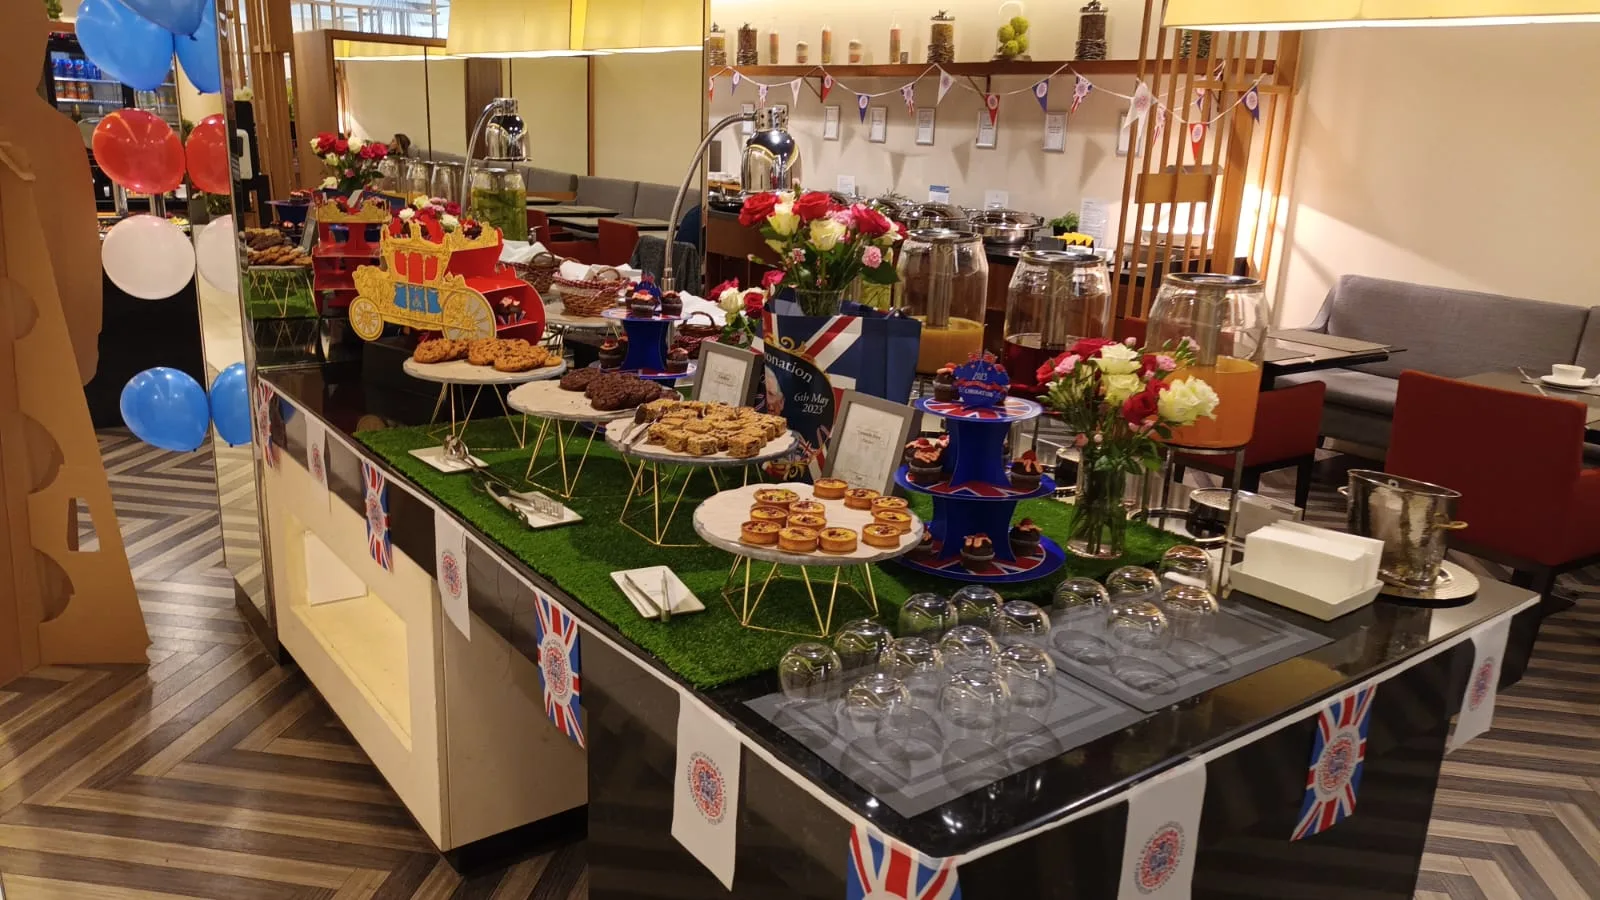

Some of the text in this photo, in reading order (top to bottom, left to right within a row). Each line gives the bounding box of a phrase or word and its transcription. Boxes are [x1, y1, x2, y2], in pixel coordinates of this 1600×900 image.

[794, 392, 829, 407] 6th May
[801, 403, 823, 415] 2023
